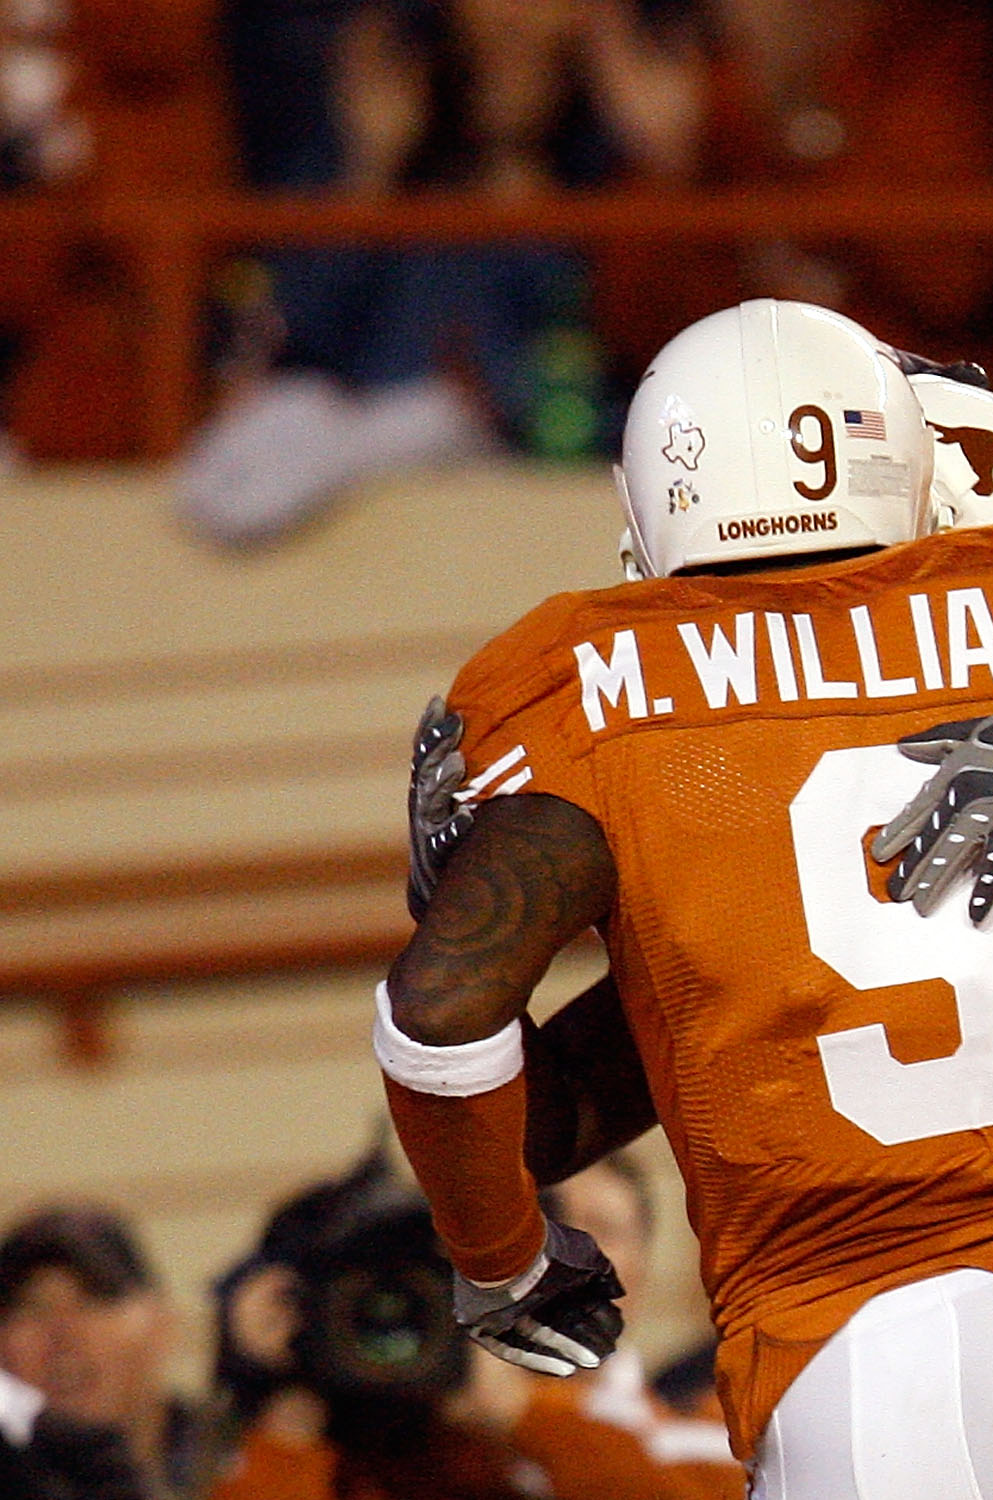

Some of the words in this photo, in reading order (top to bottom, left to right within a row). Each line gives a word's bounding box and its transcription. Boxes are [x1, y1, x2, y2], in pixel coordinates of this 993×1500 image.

[788, 404, 838, 501] 9
[717, 511, 838, 541] LONGHORNS
[573, 629, 674, 732] M.
